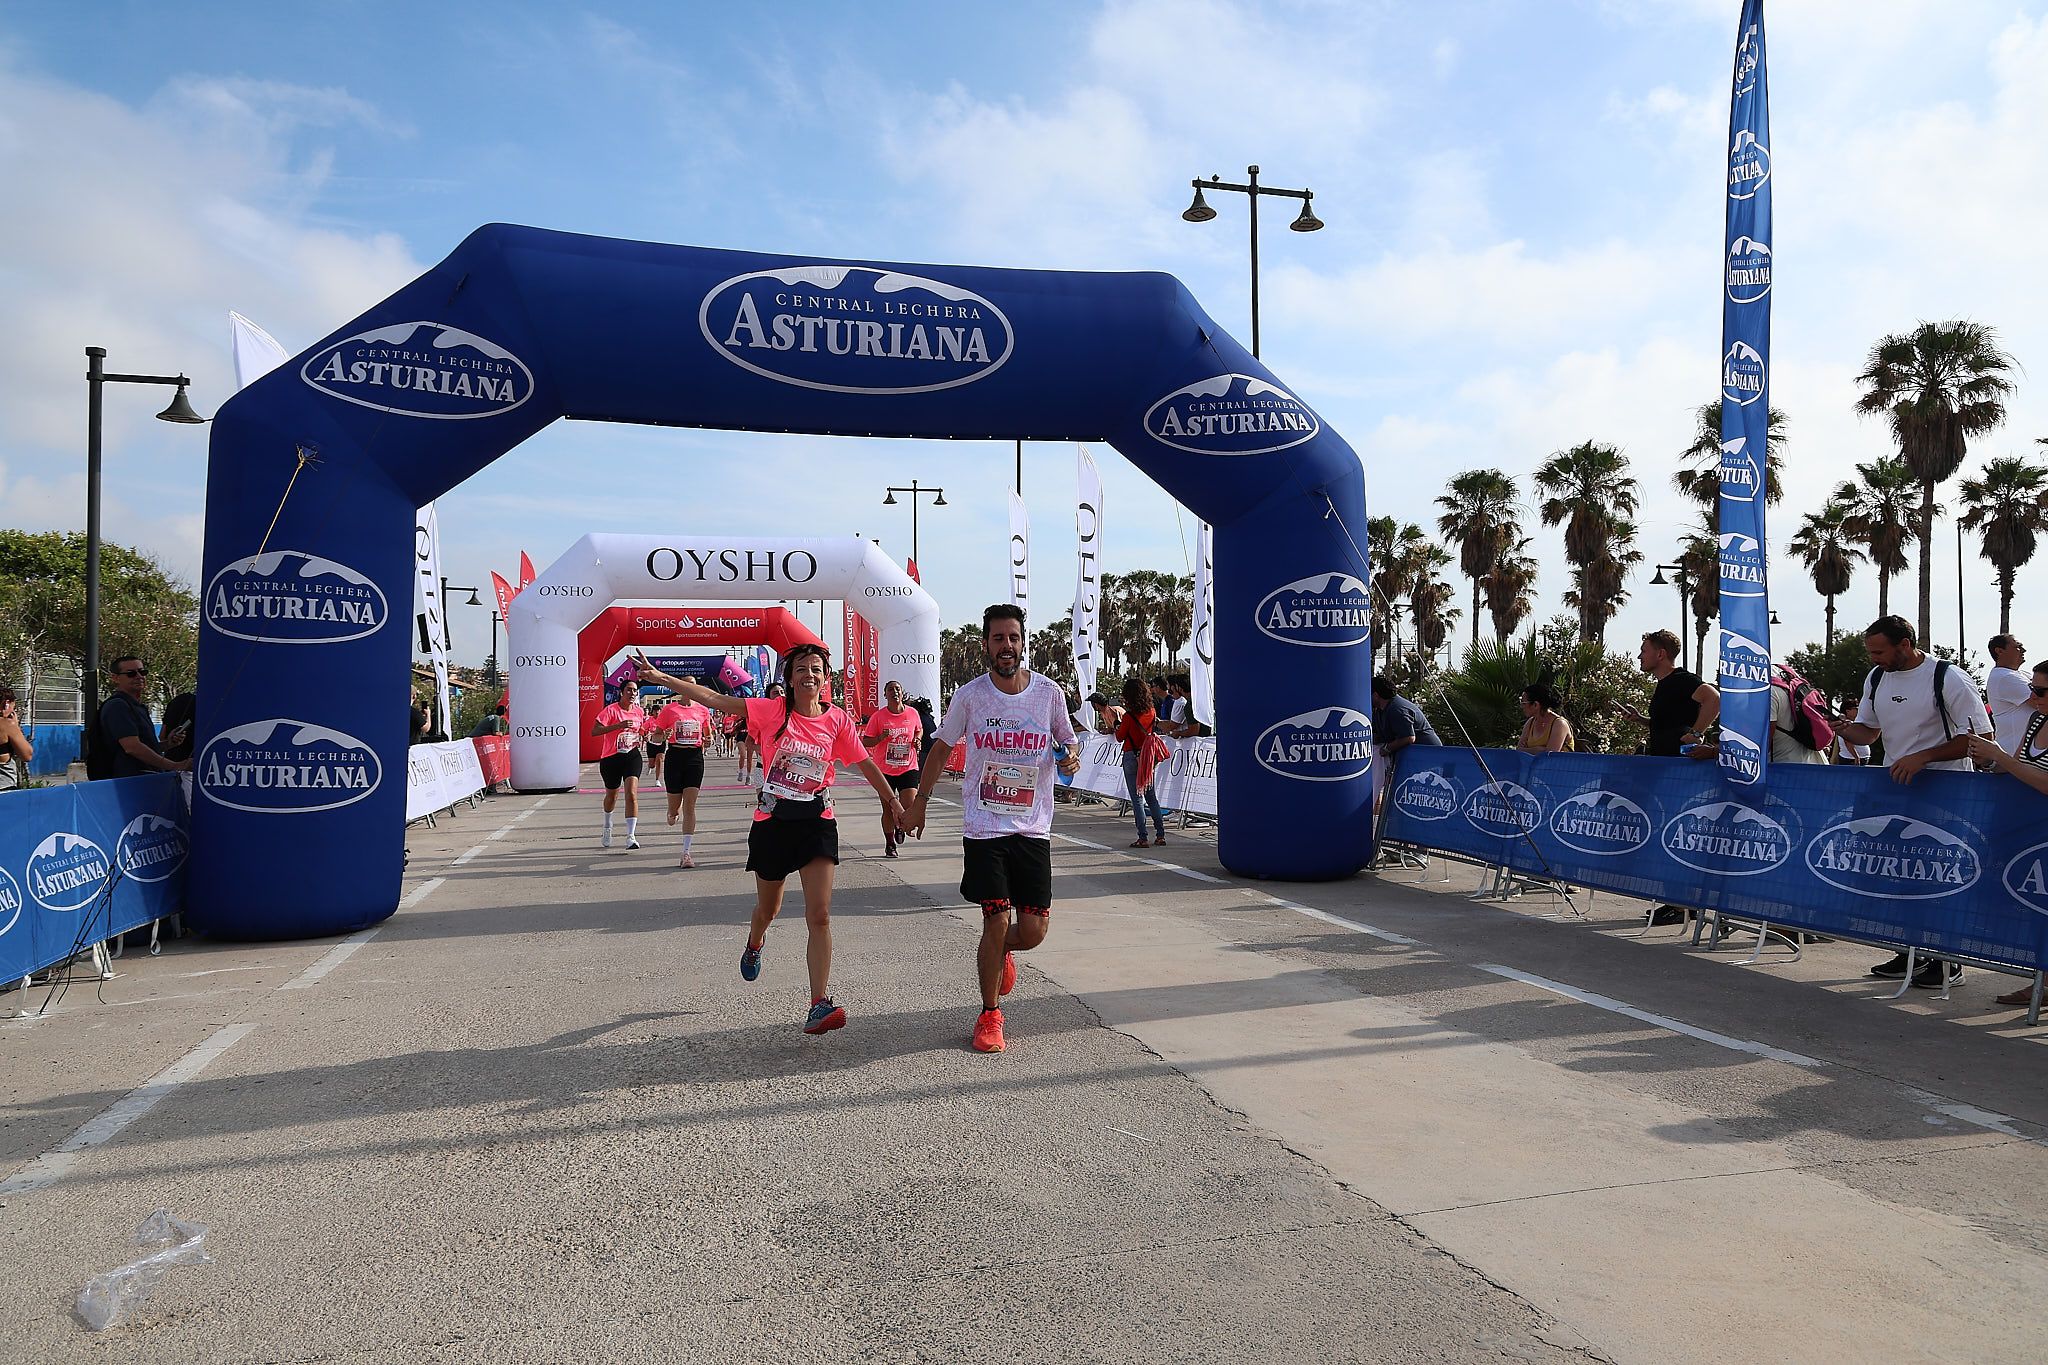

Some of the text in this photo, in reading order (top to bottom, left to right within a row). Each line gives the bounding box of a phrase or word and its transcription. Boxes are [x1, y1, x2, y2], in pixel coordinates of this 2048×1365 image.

[775, 293, 982, 320] CENTRAL LECHERA
[724, 292, 992, 363] ASTURIANA
[356, 349, 513, 375] CENTRAL LECHERA
[313, 351, 516, 403] ASTURIANA
[1188, 400, 1300, 412] CENTRAL LECHERA
[1159, 406, 1313, 436] ASTURIANA
[646, 547, 818, 583] OYSHO
[234, 581, 371, 598] CENTRAL LECHERA
[539, 585, 594, 598] OYSHO
[864, 586, 913, 597] OYSHO
[211, 584, 377, 625] ASTURIANA
[1291, 598, 1340, 606] CENTRAL
[636, 616, 761, 631] Sports Santander
[1266, 600, 1370, 629] ASTURIAN
[515, 655, 567, 668] OYSHO
[890, 653, 935, 665] OYSHO
[1719, 659, 1770, 684] RIANA
[515, 725, 567, 738] OYSHO
[985, 717, 1001, 727] 15K
[973, 729, 1047, 751] VALENCIA
[1290, 733, 1340, 741] CENTRAL
[226, 750, 365, 762] CENTRAL LECHERA
[1265, 735, 1373, 763] ASTURIANA
[204, 751, 370, 789] ASTURIANA
[1170, 747, 1217, 779] OYSH
[785, 771, 806, 784] 016
[996, 785, 1018, 797] 016
[1467, 796, 1533, 828] ASTURIANA
[1554, 809, 1641, 844] ASTURIANA
[1691, 824, 1777, 840] CENTRAL LECHERA
[1668, 823, 1778, 862] ASTURIANA
[1844, 838, 1962, 860] CENTRAL LECHERA
[1814, 839, 1966, 885] ASTURIANA
